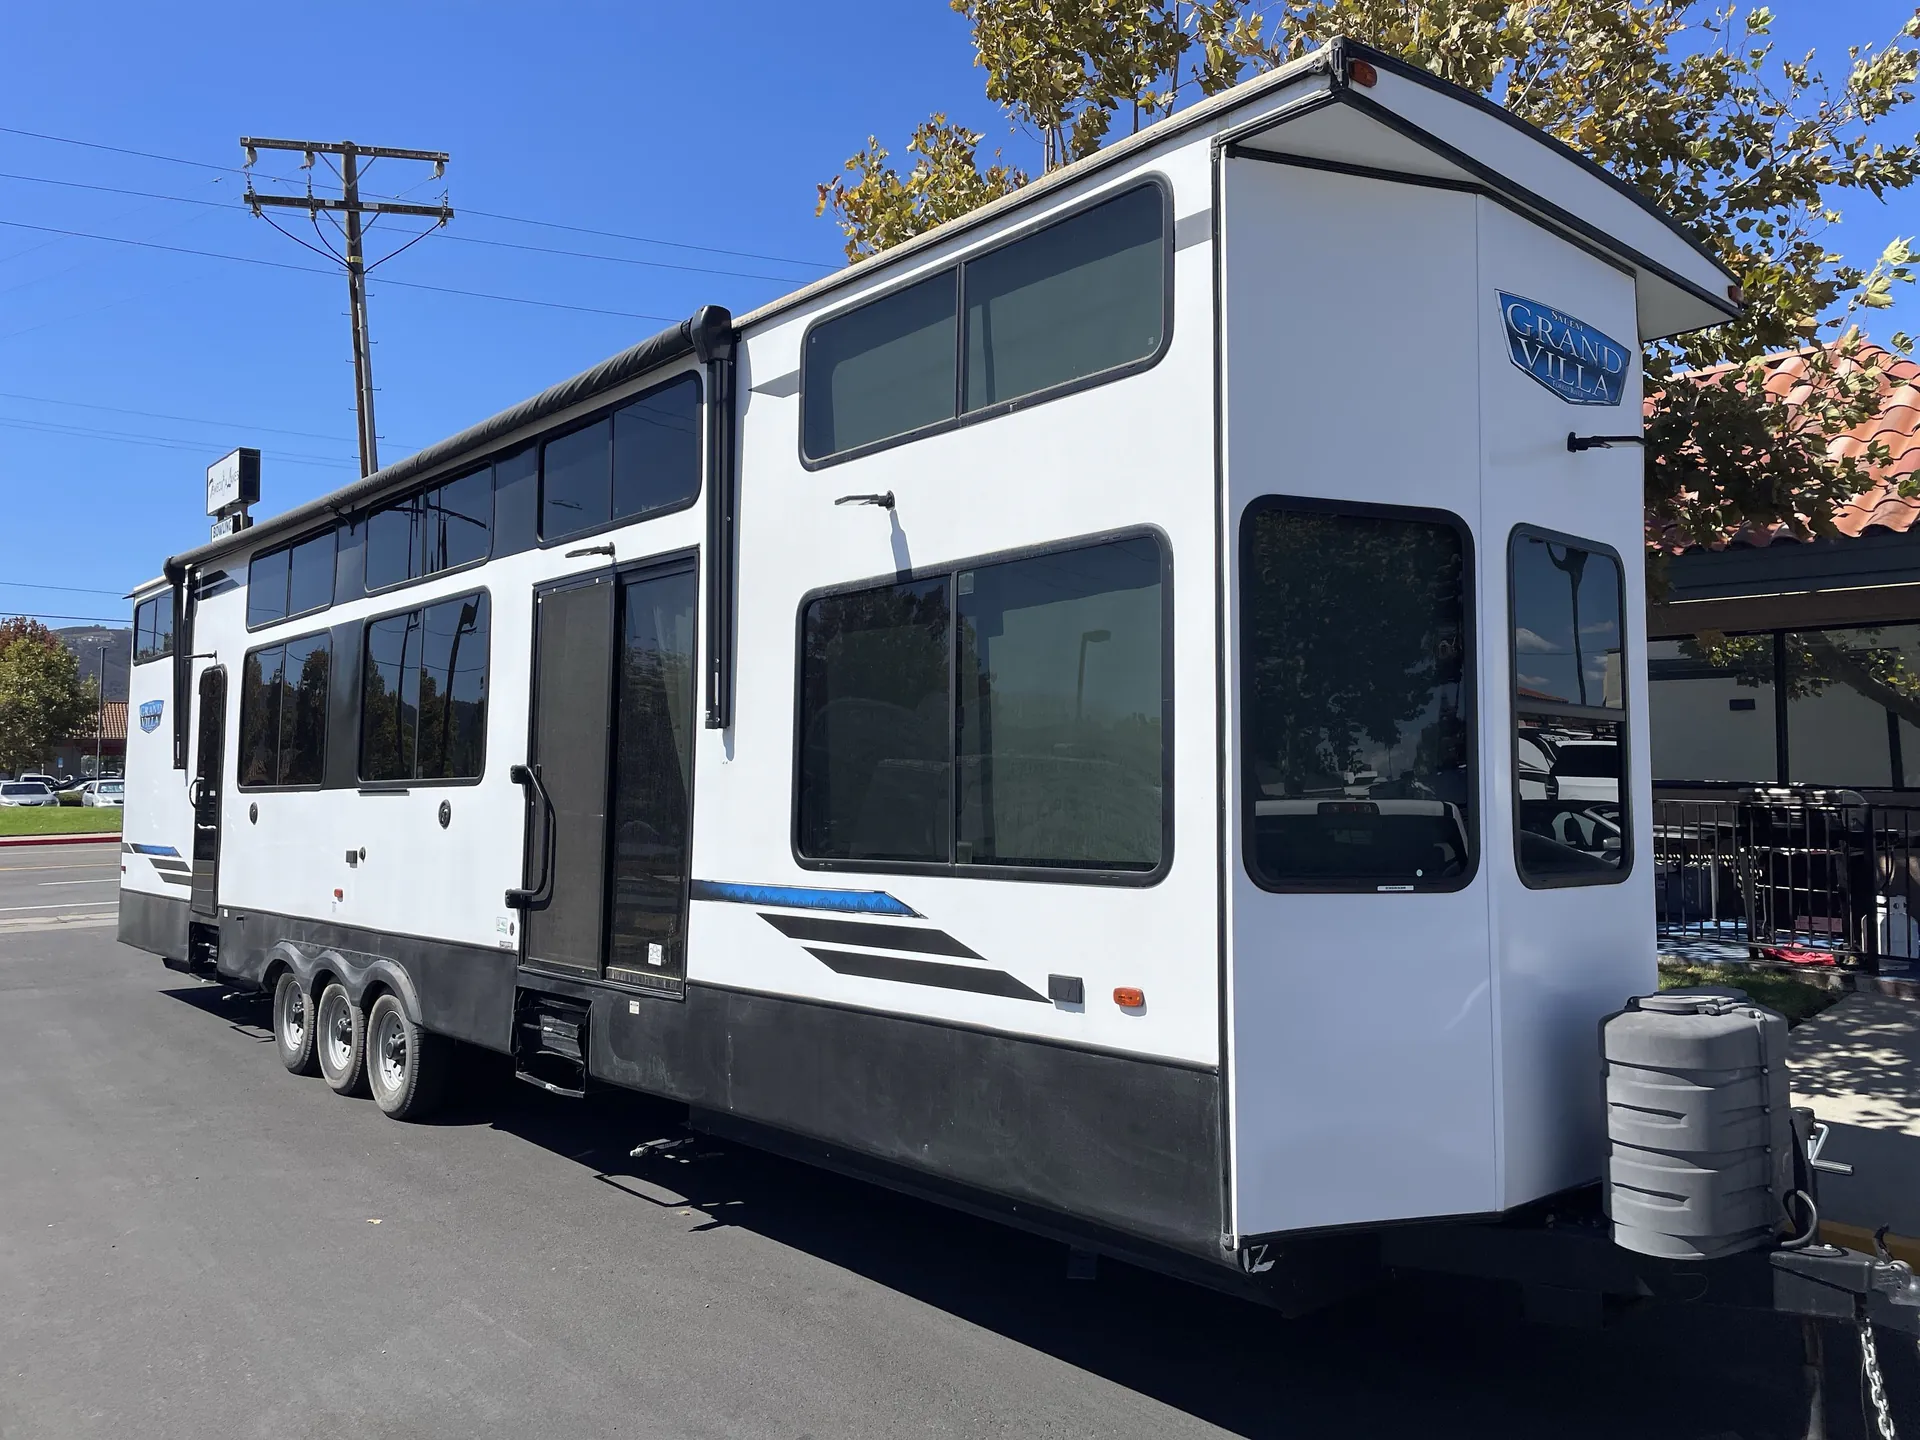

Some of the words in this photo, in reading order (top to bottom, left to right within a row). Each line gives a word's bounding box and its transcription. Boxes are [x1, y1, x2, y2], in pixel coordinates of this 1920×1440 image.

[1506, 303, 1622, 374] GRAND
[1551, 310, 1583, 332] SALEM
[1517, 336, 1609, 401] VILLA
